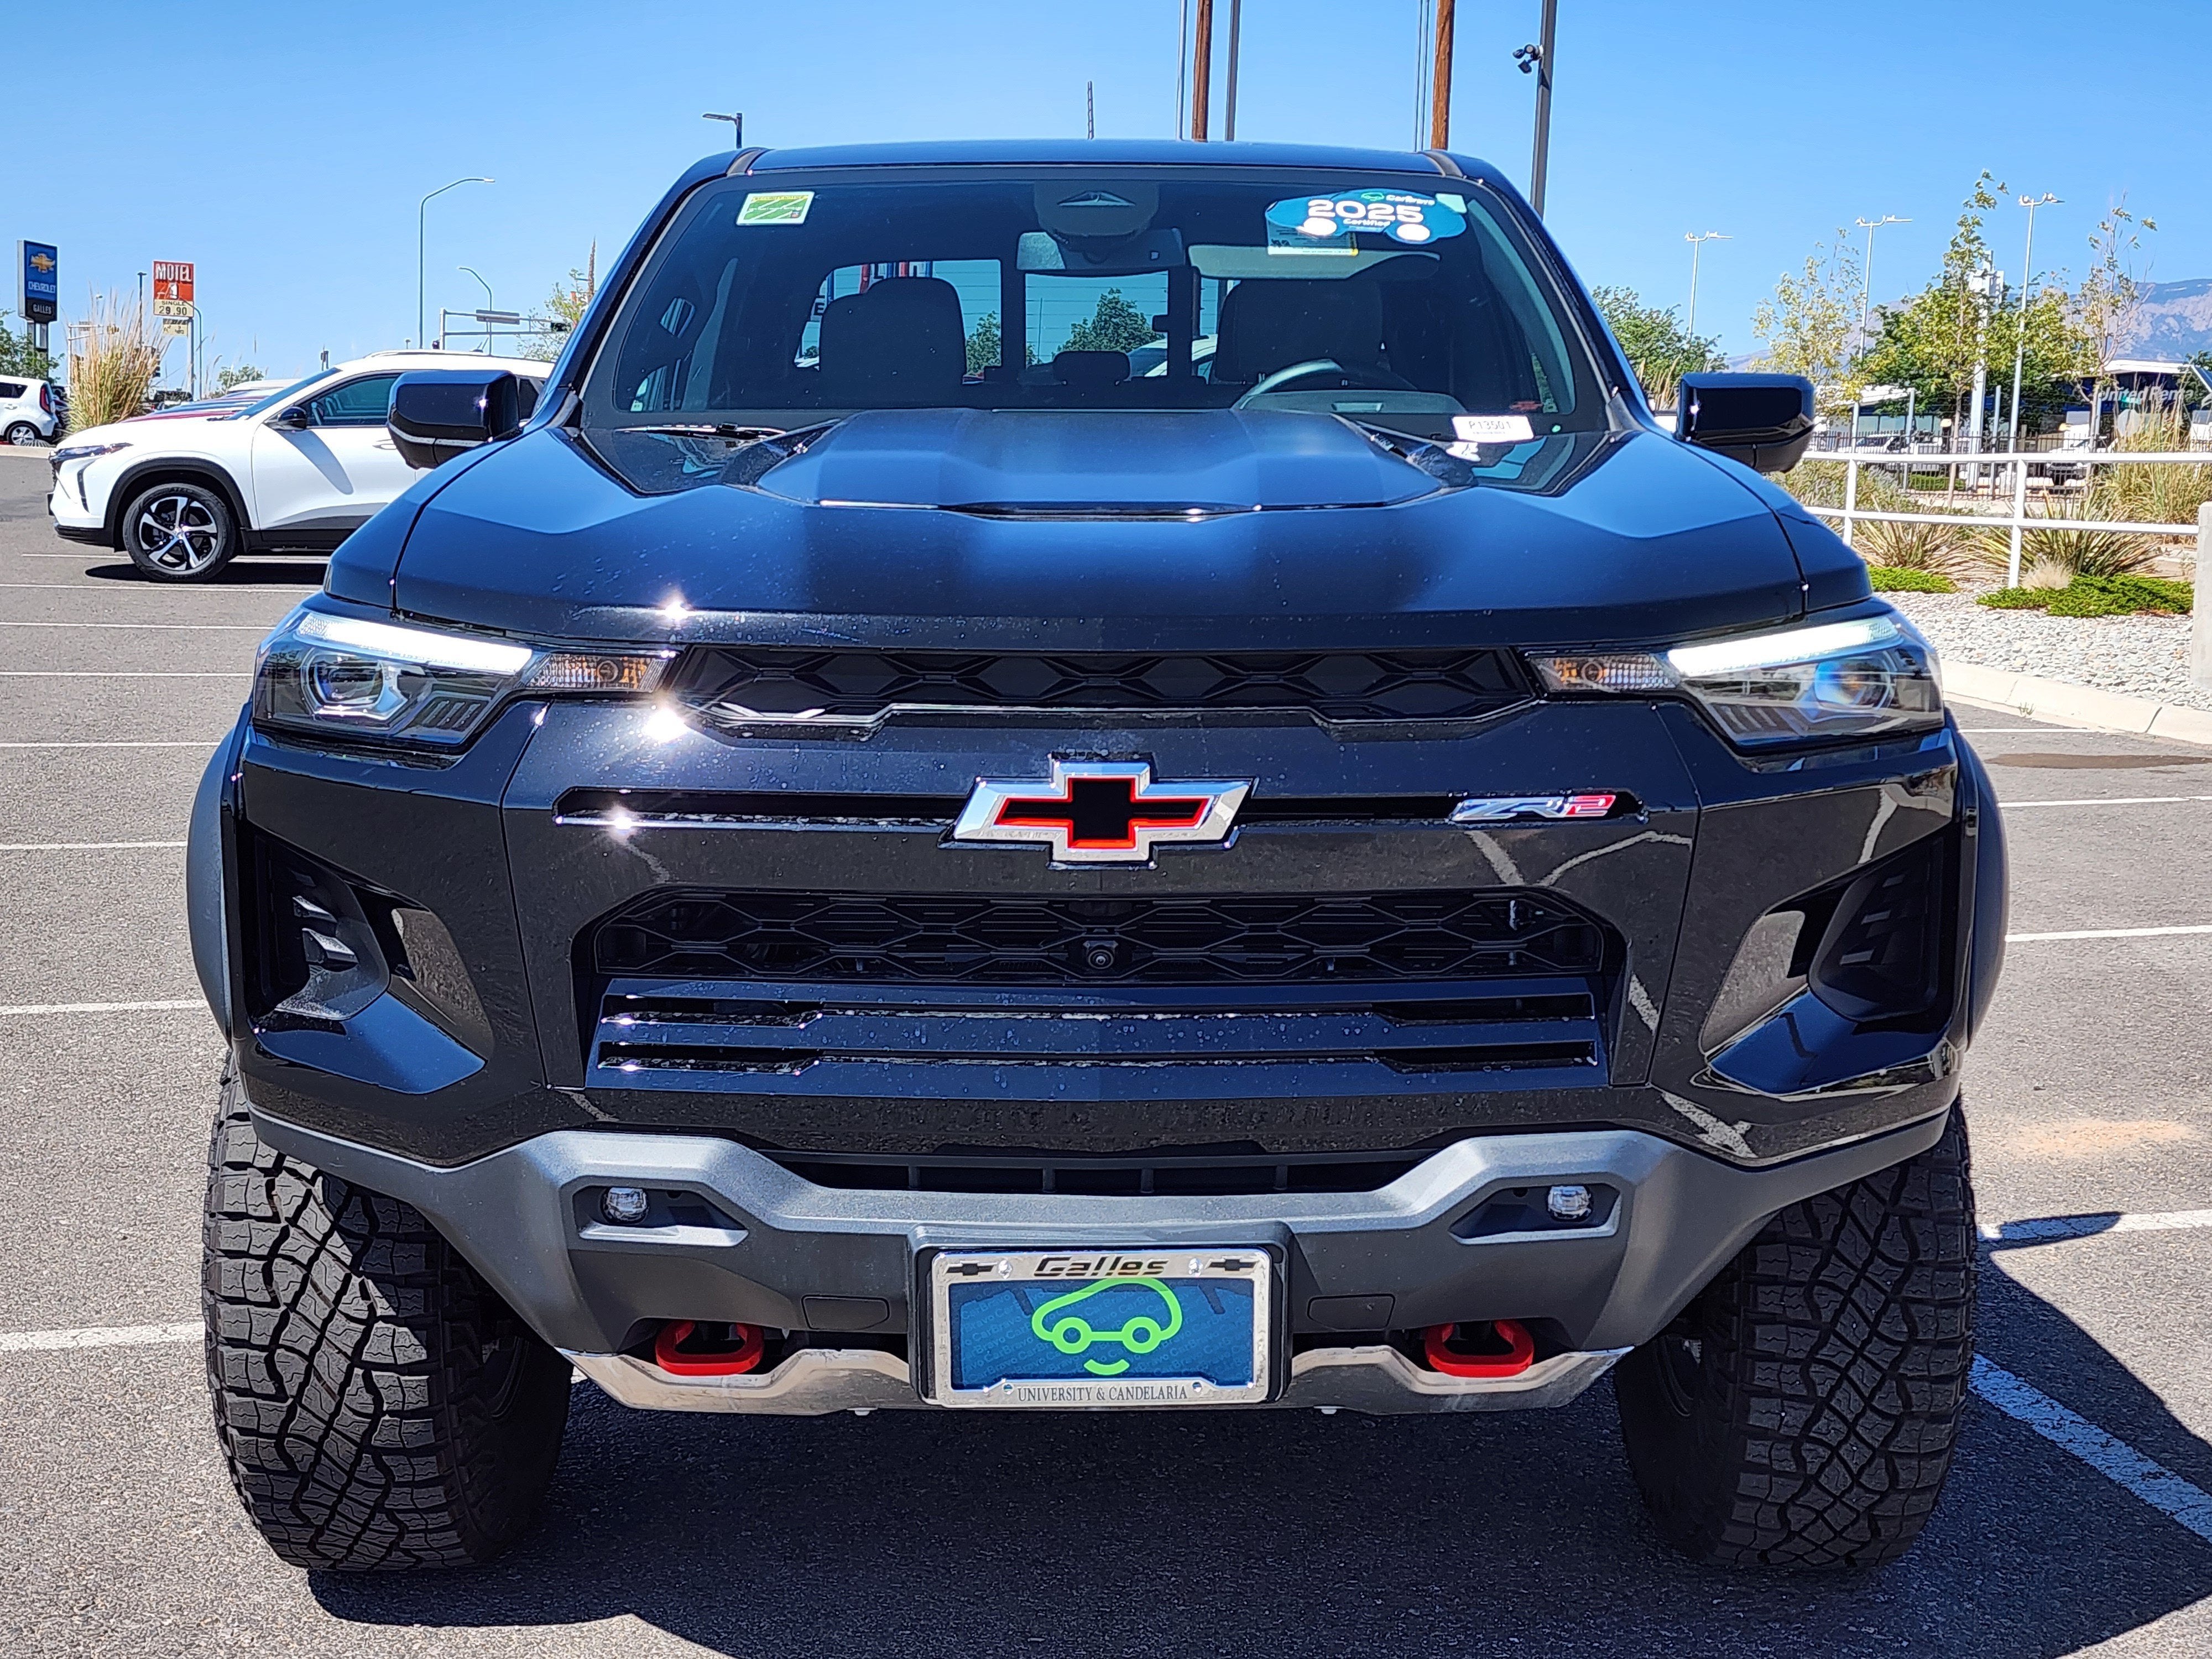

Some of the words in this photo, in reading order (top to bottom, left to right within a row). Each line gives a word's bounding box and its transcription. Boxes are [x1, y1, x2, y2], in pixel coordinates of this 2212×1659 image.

[1308, 199, 1424, 223] 2025
[155, 263, 192, 281] MOTEL
[33, 304, 51, 315] GALLES
[159, 305, 187, 316] 29.90
[1469, 421, 1511, 430] P13501
[1449, 795, 1616, 821] ZR2
[1034, 1255, 1169, 1277] Galles
[1018, 1386, 1093, 1401] UNIVERSITY
[1096, 1386, 1105, 1401] &
[1109, 1385, 1188, 1401] CANDELARIA
